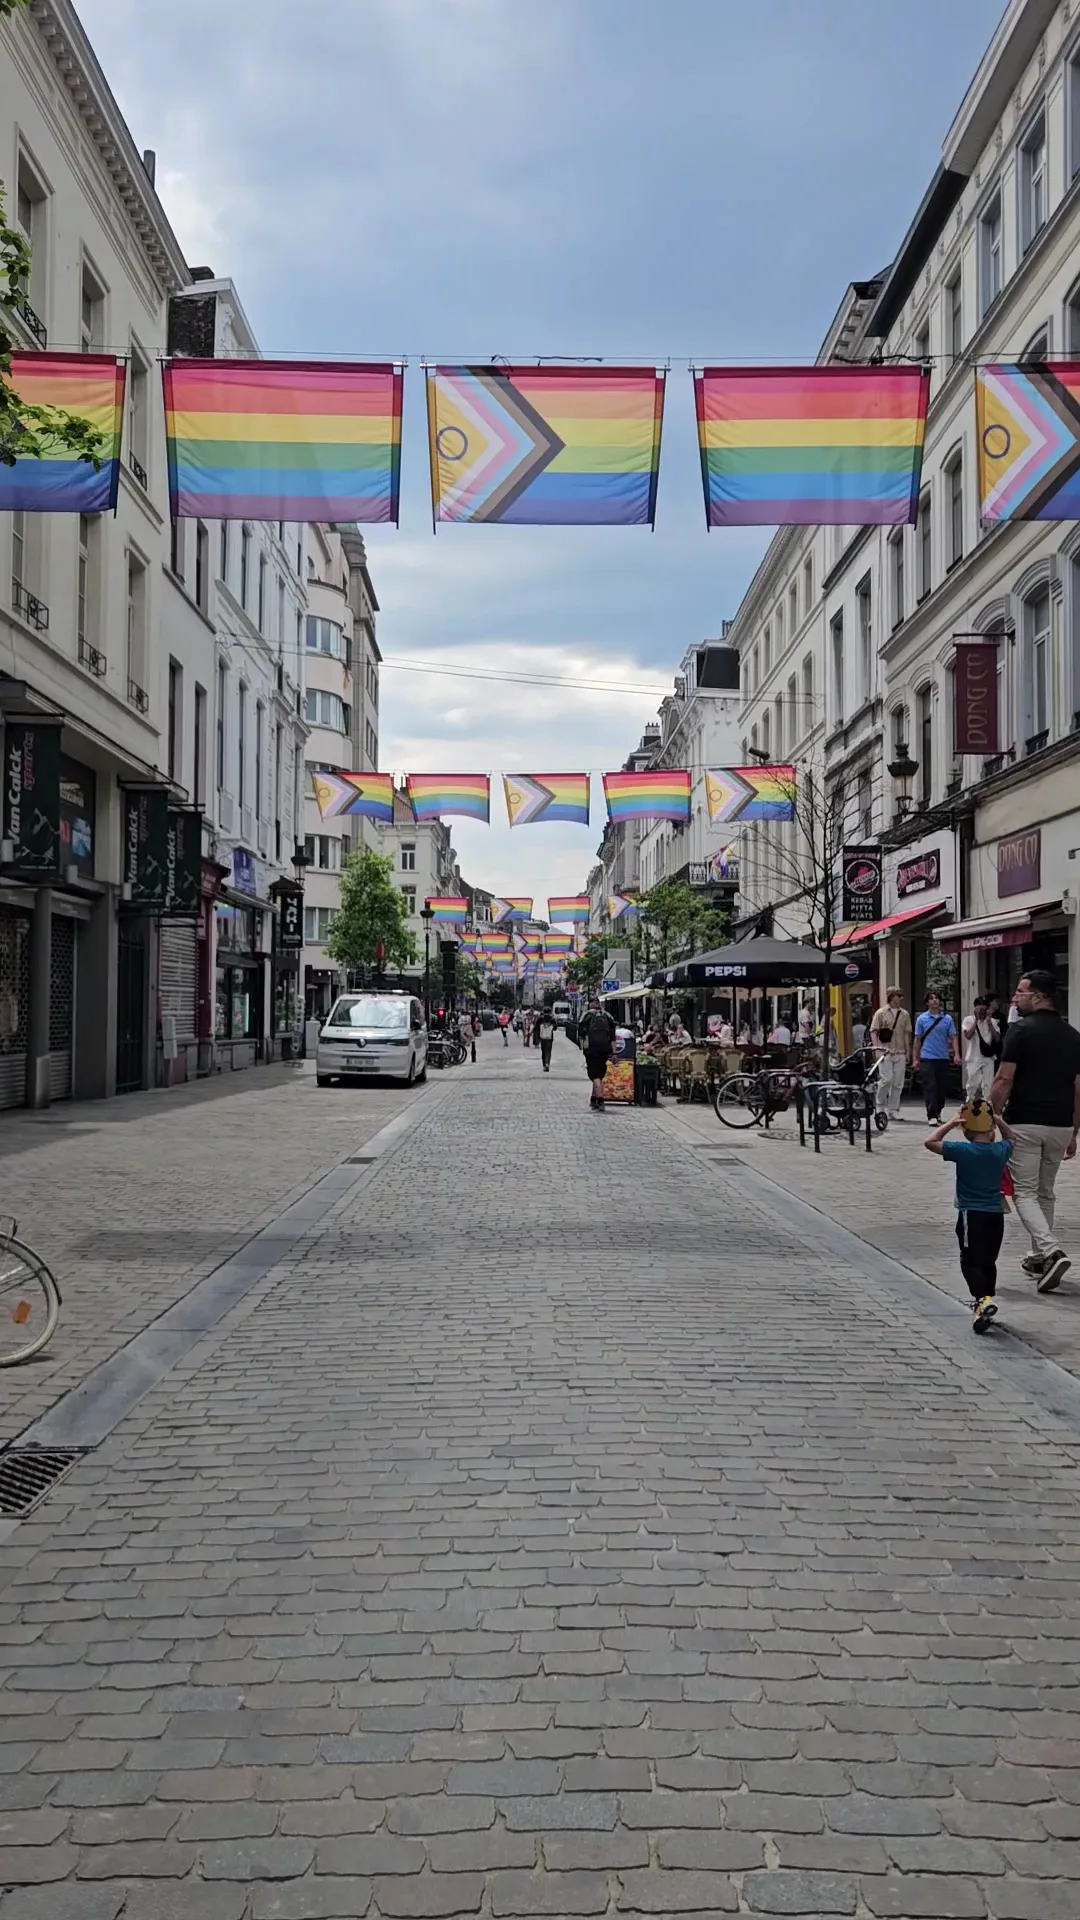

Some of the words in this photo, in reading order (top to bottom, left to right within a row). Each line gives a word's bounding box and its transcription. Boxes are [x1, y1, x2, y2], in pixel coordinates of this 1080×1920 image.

[967, 653, 988, 680] CO
[967, 687, 988, 744] DONG
[999, 840, 1024, 872] DONG
[1025, 834, 1038, 865] CO
[705, 965, 747, 977] PEPSI
